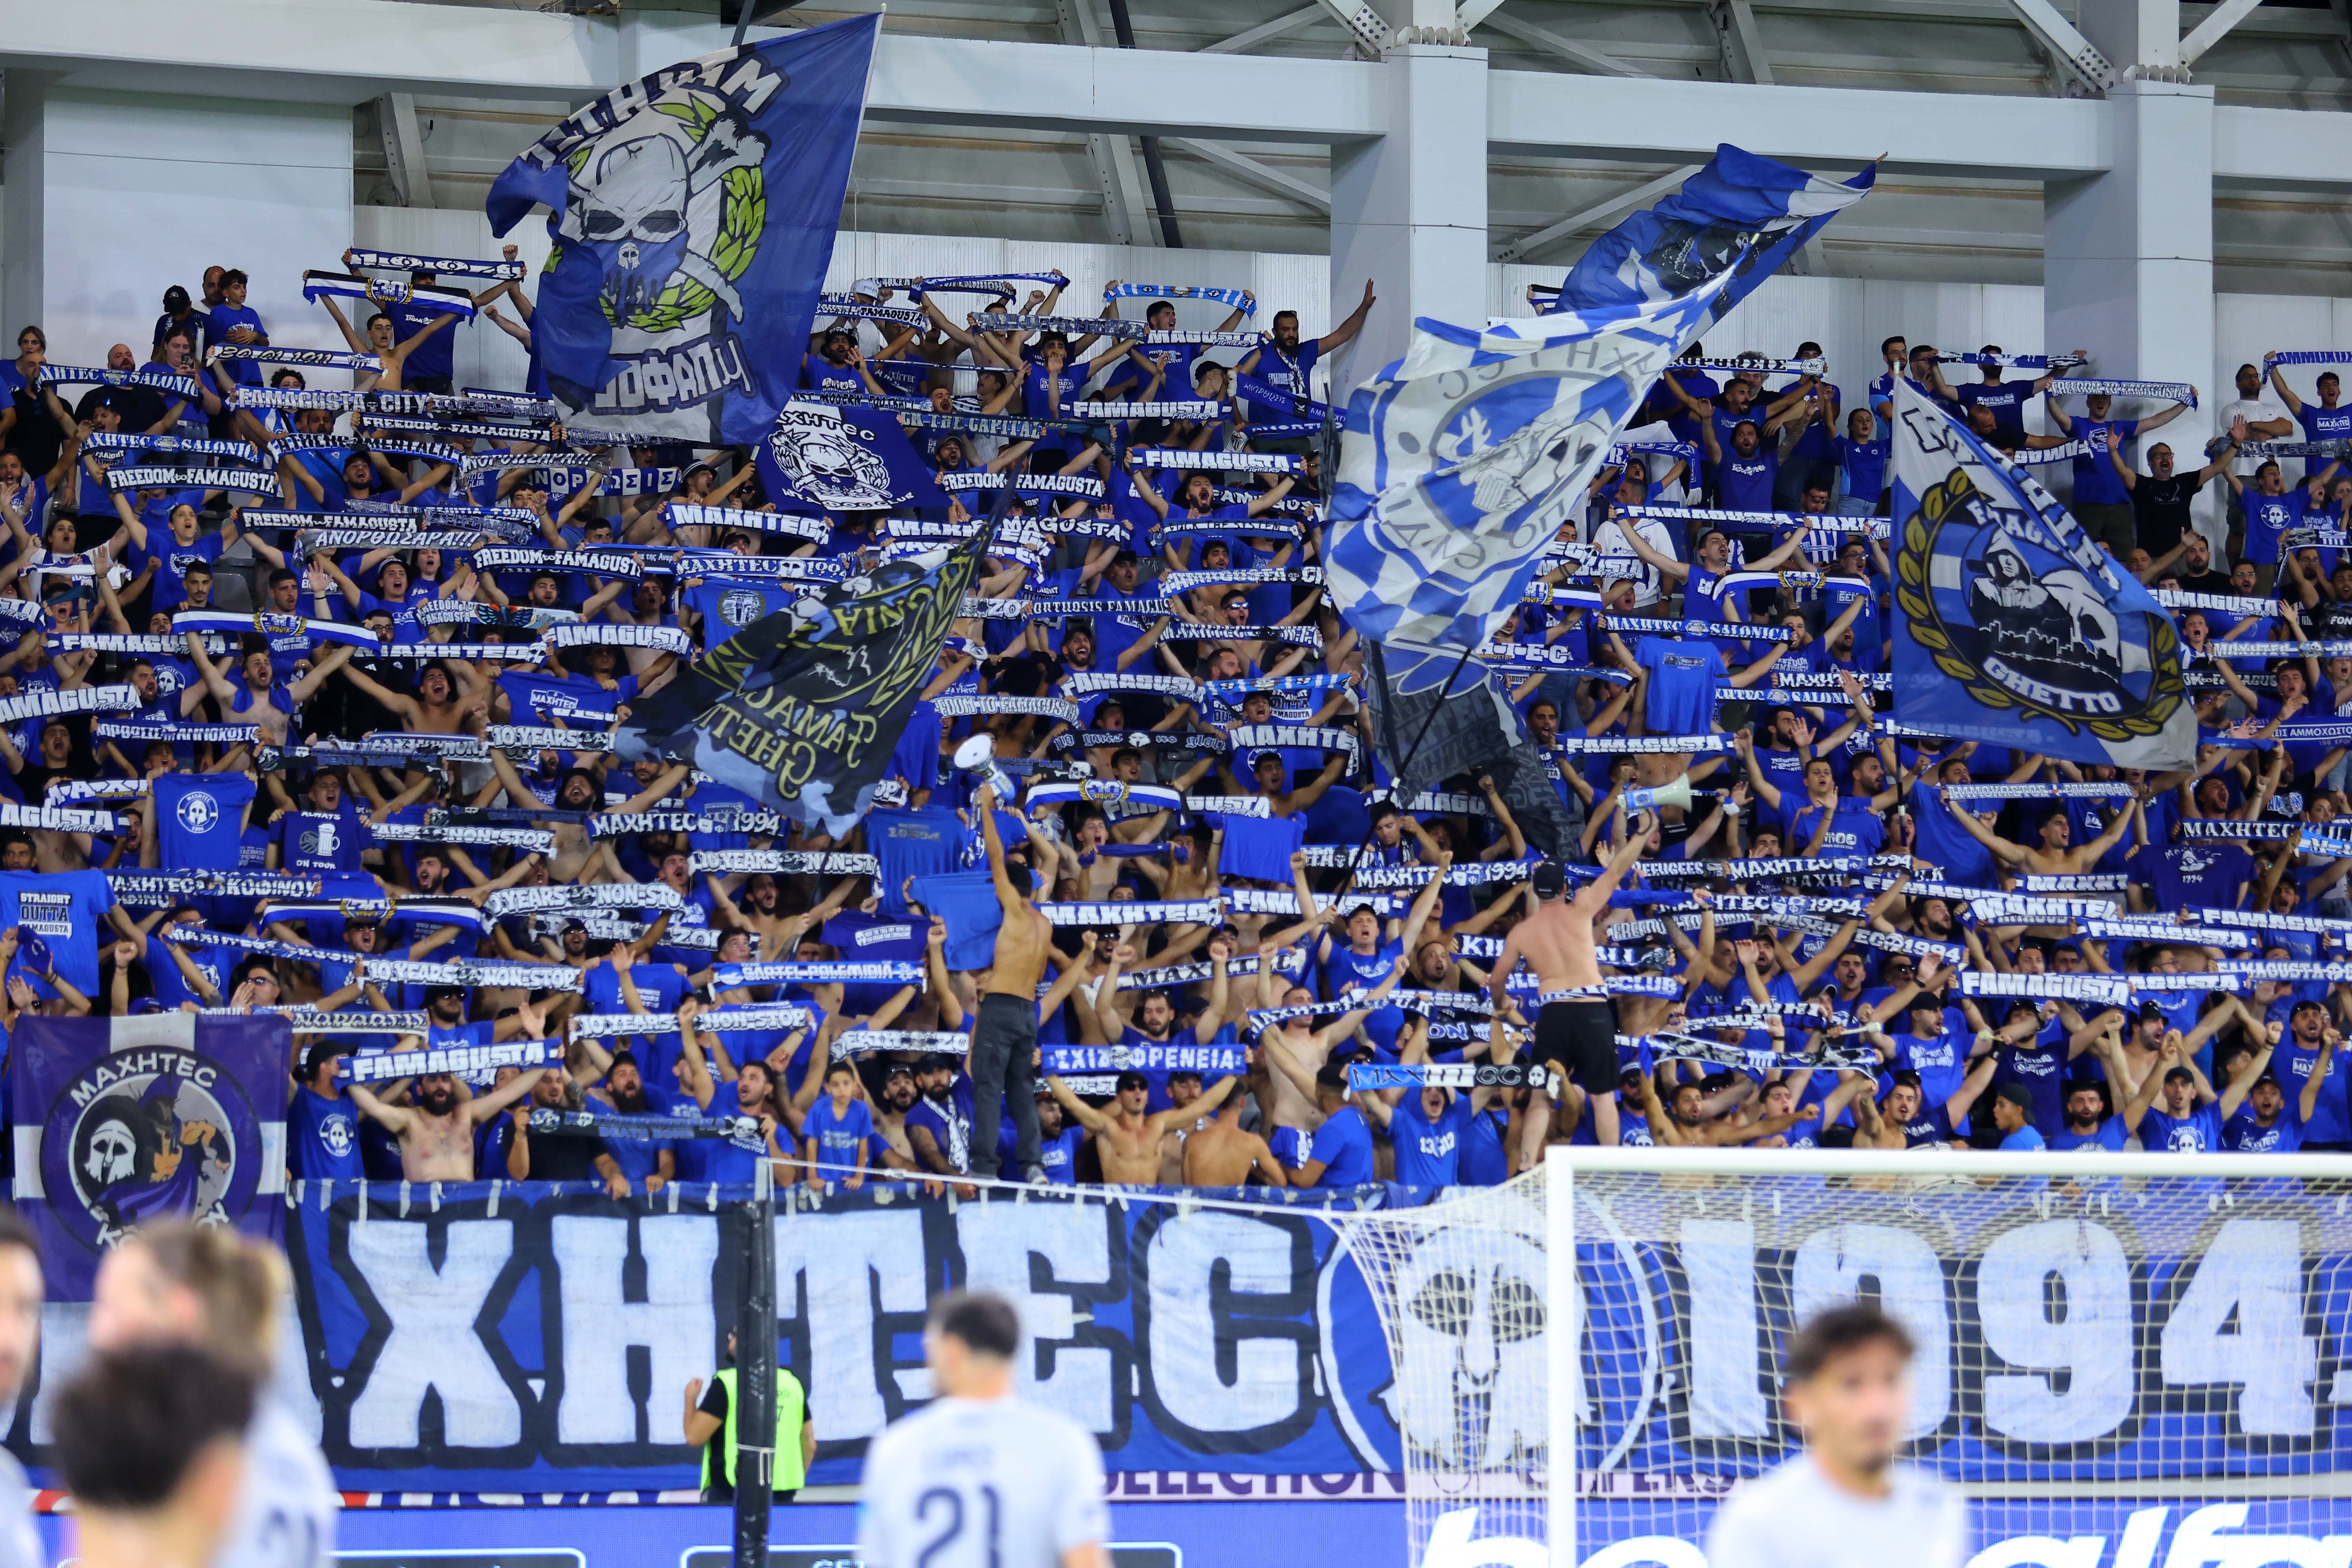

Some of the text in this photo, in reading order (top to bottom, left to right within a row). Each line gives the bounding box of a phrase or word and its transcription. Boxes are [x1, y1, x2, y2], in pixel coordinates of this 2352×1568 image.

[1147, 331, 1259, 345] MAGUSTA
[238, 386, 366, 413] FAMAGUSTA
[381, 393, 427, 414] CITY
[1073, 401, 1218, 418] FAMAGUSTA
[363, 416, 438, 432] FREEDOM
[451, 423, 551, 441] FAMAGUSTA
[968, 417, 1040, 441] CAPITAL
[83, 432, 151, 455] AXHTEC
[1145, 451, 1290, 470] FAMAGUSTA
[108, 468, 176, 489] FREEDOM
[187, 468, 275, 495] FAMAGUSTA
[943, 473, 1103, 498] FREEDOM FAMAGUSTA
[245, 512, 314, 529] FREEDOM
[325, 515, 417, 534] FAMAGUSTA
[674, 505, 819, 538] MAXHTEC
[1626, 505, 1794, 524] FAMAGUSTA
[475, 549, 544, 569] FREEDOM
[1033, 599, 1171, 615] ORTHOSIS FAMAGUS
[2156, 589, 2279, 617] AMAGUSTA
[1607, 616, 1789, 641] MAXHTEC SALONICA
[1983, 655, 2123, 715] GHETTO
[0, 684, 142, 722] AMAGUSTA
[1270, 709, 1311, 719] AMAGUSTA
[517, 727, 580, 747] YEARS
[2290, 726, 2352, 739] ΑΜΜΟΧΩΣΤΟ
[1567, 735, 1723, 755] FAMAGUSTA
[1, 803, 114, 831] AGUSTA
[301, 811, 341, 821] ALWAYS
[592, 812, 780, 836] MAXHTEC 1994
[2183, 822, 2295, 838] MAXHTEC
[296, 859, 337, 870] ON TOUR
[721, 850, 780, 873] YEARS
[1728, 857, 1829, 880] MAXHTEC
[20, 892, 71, 905] STRAIGHT
[508, 887, 567, 910] YEARS
[1807, 897, 1862, 915] 1994
[20, 905, 69, 922] OUTTA
[1040, 904, 1208, 925] MAXHTEC
[2201, 908, 2352, 936] FAMAGUS
[367, 960, 579, 987] 10 YEARS NON-STOP
[1961, 971, 2129, 1006] FAMAGUSTA
[610, 1015, 673, 1036] YEARS
[706, 1009, 807, 1031] NON-STOP
[354, 1041, 544, 1082] FAMAGUSTA
[69, 1051, 219, 1109] MAXHTEC
